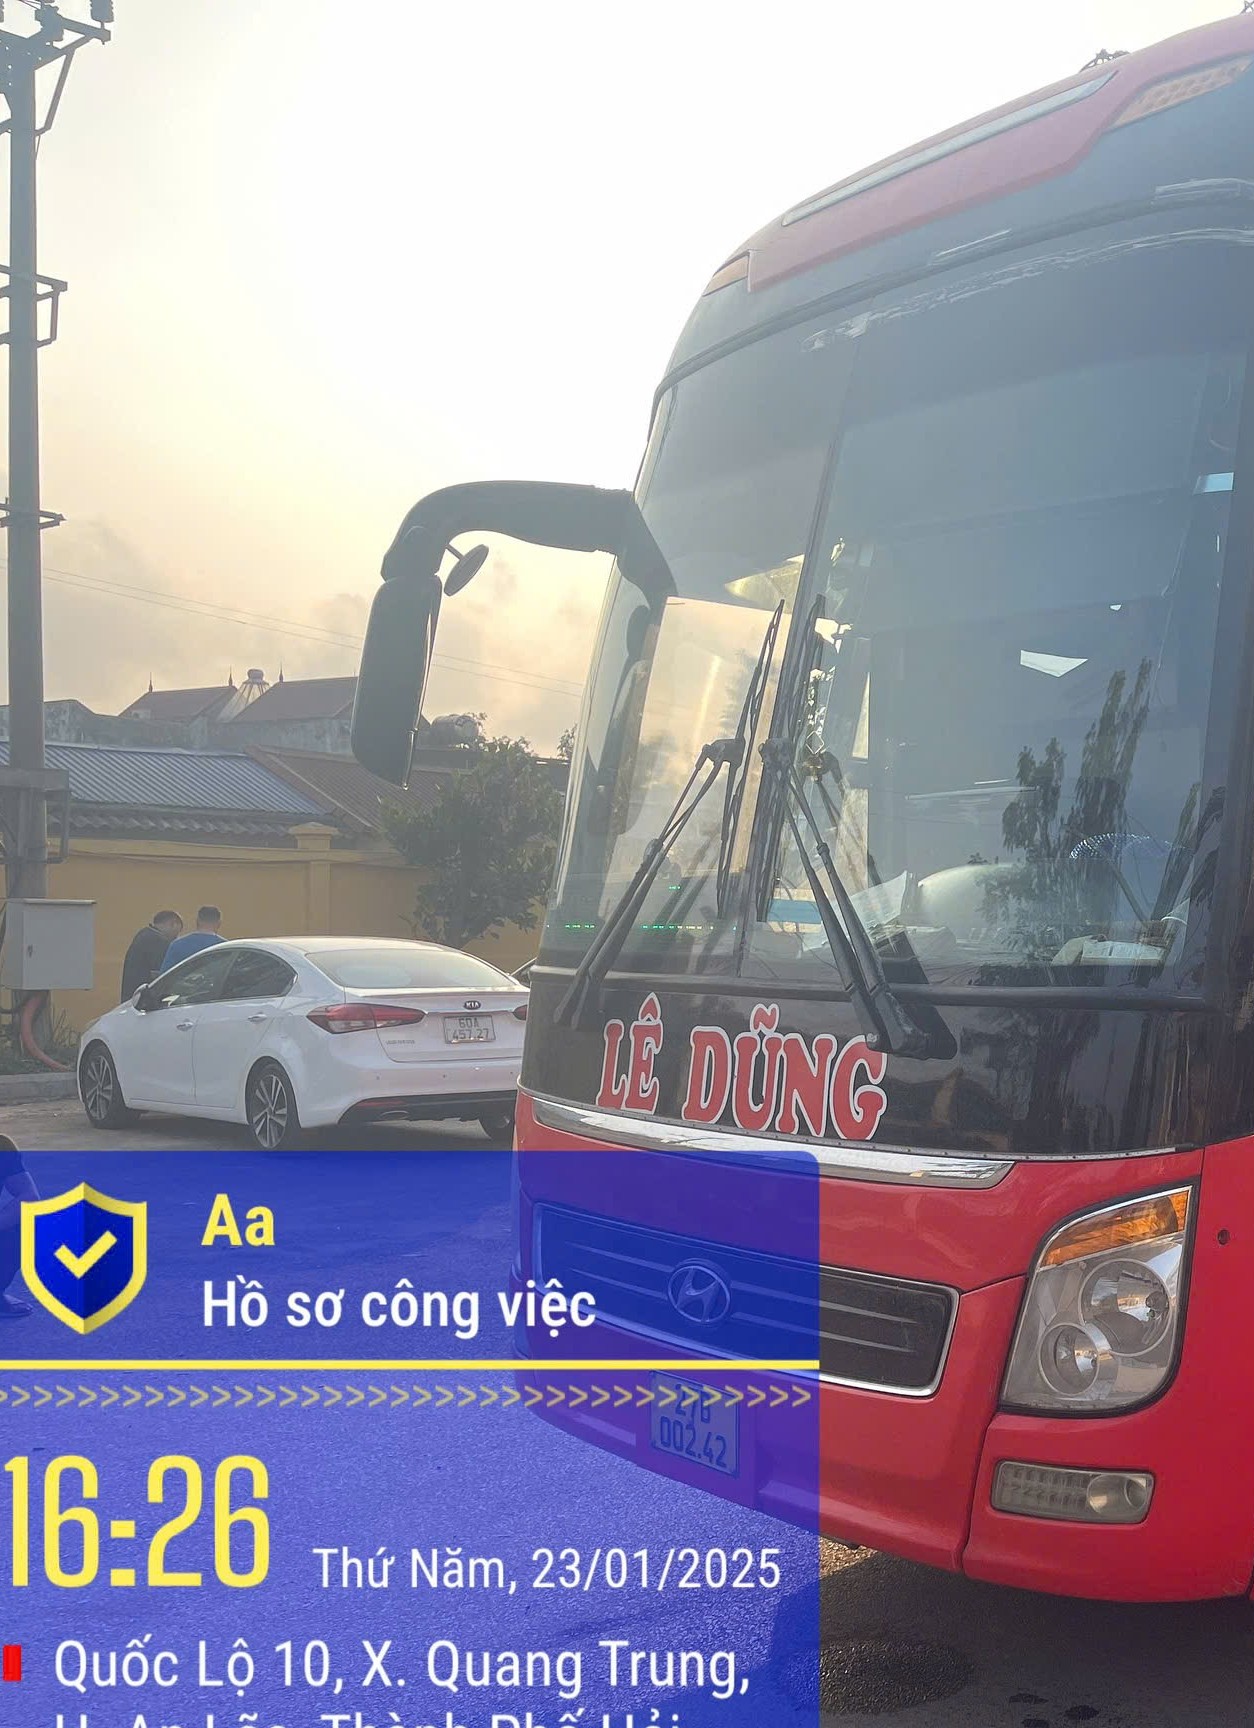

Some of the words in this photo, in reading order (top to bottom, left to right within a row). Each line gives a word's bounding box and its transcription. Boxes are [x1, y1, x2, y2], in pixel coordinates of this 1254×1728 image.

[596, 992, 664, 1116] LÊ
[681, 1003, 888, 1142] DŨNG
[660, 1415, 728, 1469] 002.42
